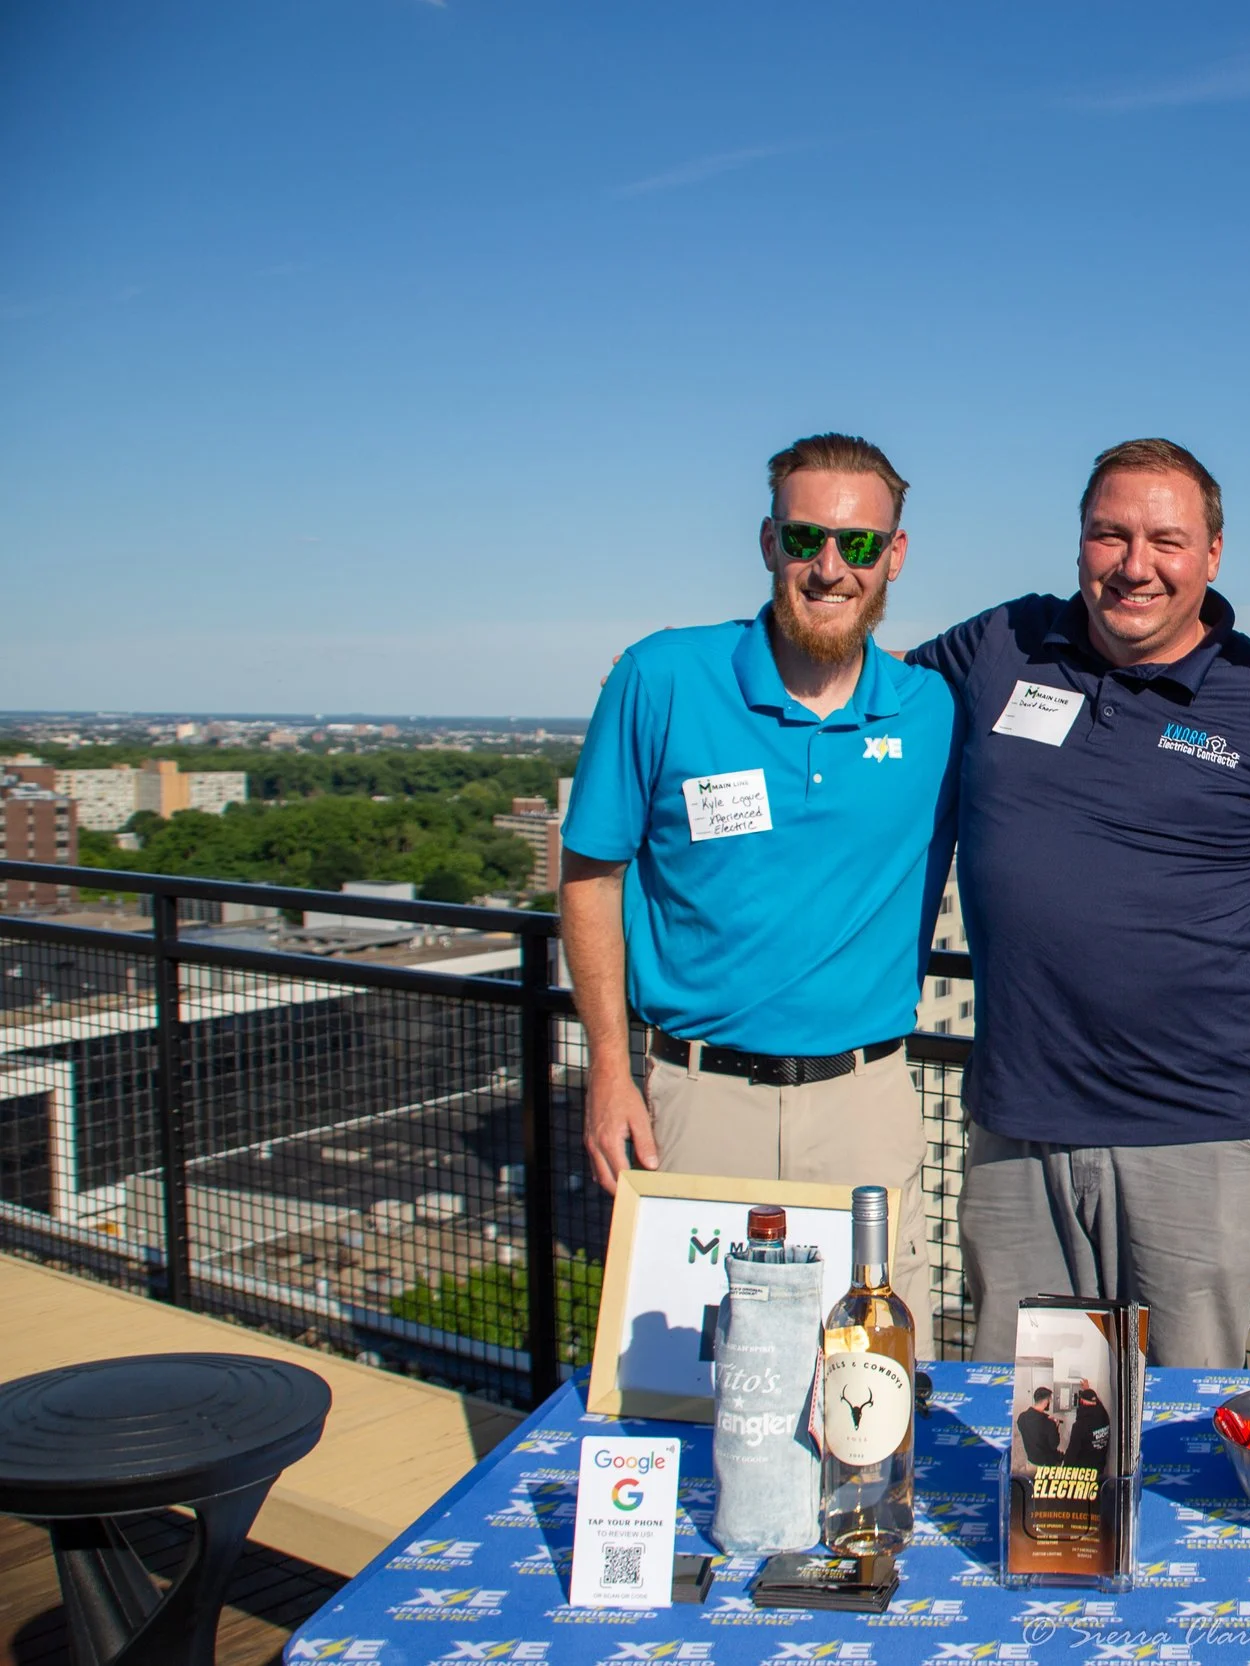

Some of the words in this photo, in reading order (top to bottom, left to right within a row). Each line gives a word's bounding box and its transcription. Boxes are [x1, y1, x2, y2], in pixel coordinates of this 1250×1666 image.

[1054, 697, 1068, 705] LINE
[1164, 723, 1207, 746] KNORR
[1158, 738, 1195, 756] Electrical
[1196, 747, 1238, 768] Contractor
[702, 797, 724, 815] Kyle
[864, 1362, 903, 1389] COWBOYS
[595, 1449, 665, 1475] Google
[1034, 1466, 1098, 1481] XPERIENCED
[1033, 1480, 1099, 1501] ELECTRIC
[588, 1518, 604, 1526] TAP
[634, 1519, 664, 1527] PHONE
[385, 1606, 502, 1616] XPERIENCED
[392, 1613, 480, 1622] ELECTRIC
[856, 1614, 968, 1622] XPERIENCED
[552, 1616, 637, 1624] ELECTRIC
